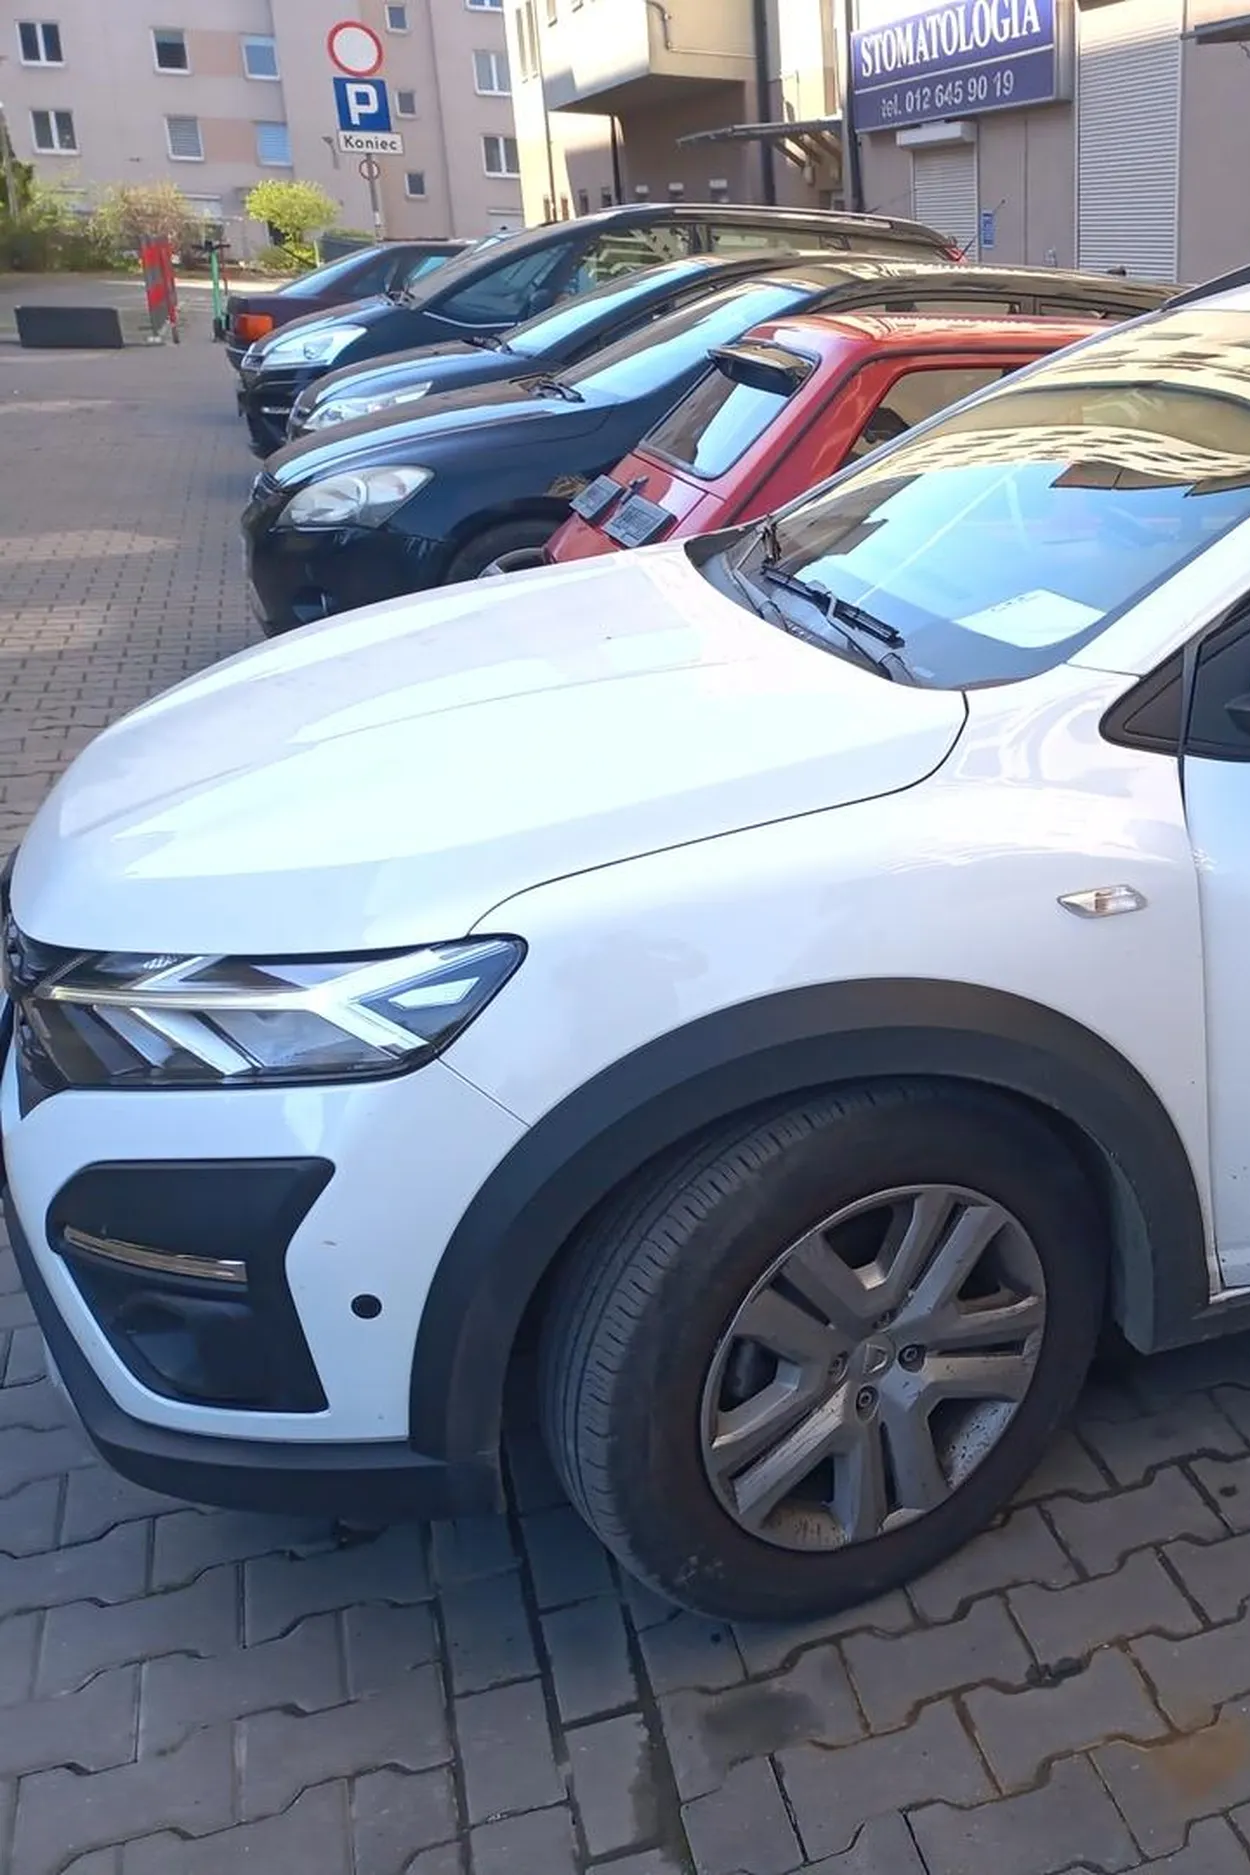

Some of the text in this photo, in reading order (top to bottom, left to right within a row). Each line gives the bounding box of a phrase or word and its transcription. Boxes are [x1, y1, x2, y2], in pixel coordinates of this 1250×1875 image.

[861, 0, 1041, 78] STOMATOLOGIA
[345, 83, 378, 125] P
[880, 69, 1015, 119] tel. 012 645 90 19
[343, 135, 398, 150] Koniec
